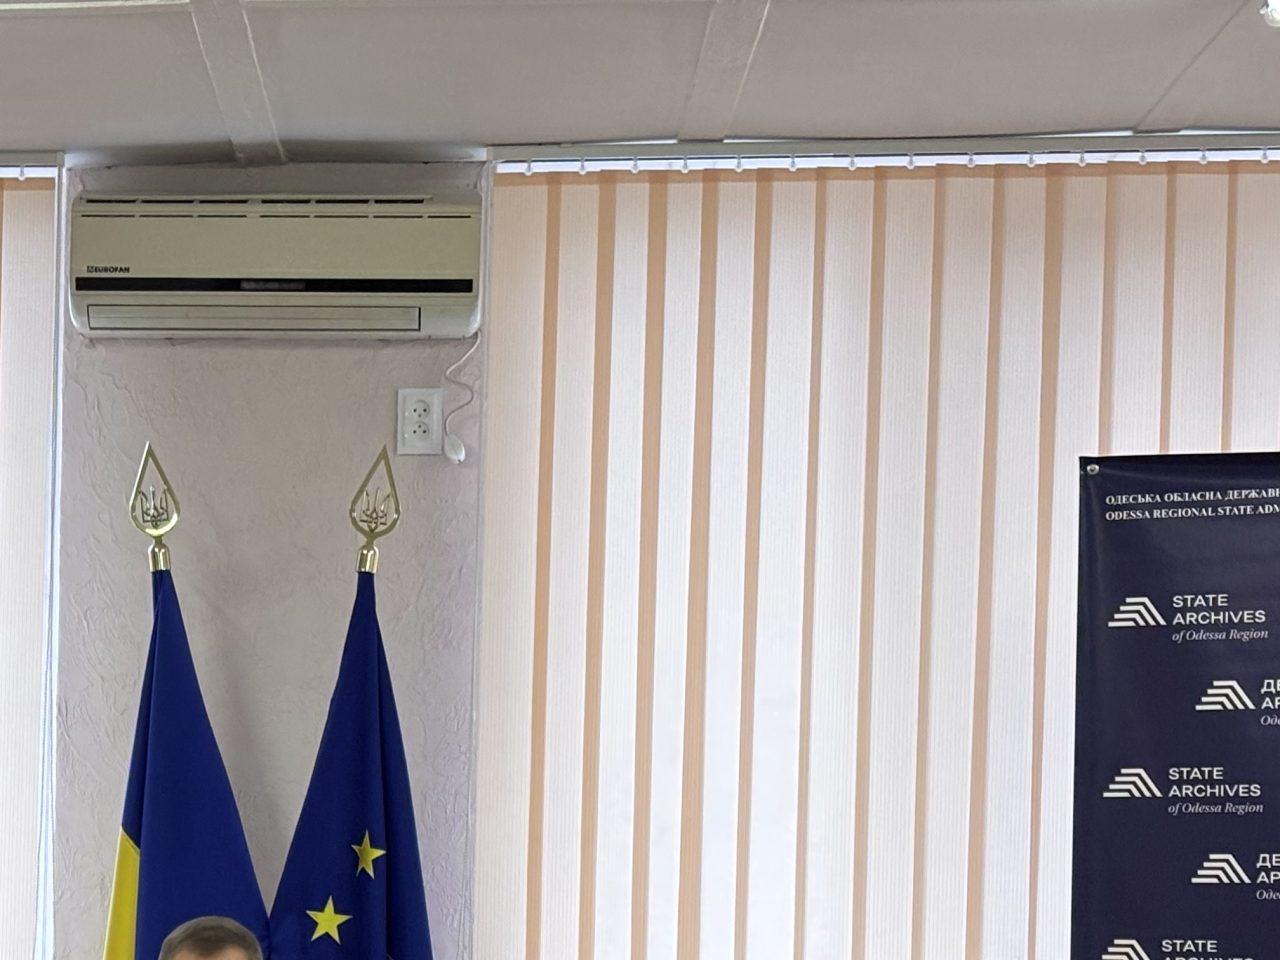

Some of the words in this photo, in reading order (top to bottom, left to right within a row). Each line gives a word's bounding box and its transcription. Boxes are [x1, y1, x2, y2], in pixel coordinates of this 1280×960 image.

[1106, 493, 1161, 505] ОДЕСЬКА
[1164, 490, 1223, 502] ОБЛАСНА
[1224, 487, 1280, 501] ДЕРЖАВ
[1106, 509, 1150, 520] ODESSA
[1153, 507, 1216, 518] REGIONAL
[1217, 505, 1254, 516] STATE
[1172, 594, 1229, 608] STATE
[1172, 610, 1266, 625] ARCHIVES
[1172, 629, 1186, 644] of
[1187, 629, 1227, 641] Odessa
[1229, 628, 1269, 642] Region
[1168, 767, 1224, 780] STATE
[1168, 784, 1262, 797] ARCHIVES
[1168, 803, 1182, 816] of
[1182, 802, 1222, 813] Odessa
[1224, 802, 1264, 815] Region
[1161, 939, 1218, 952] STATE
